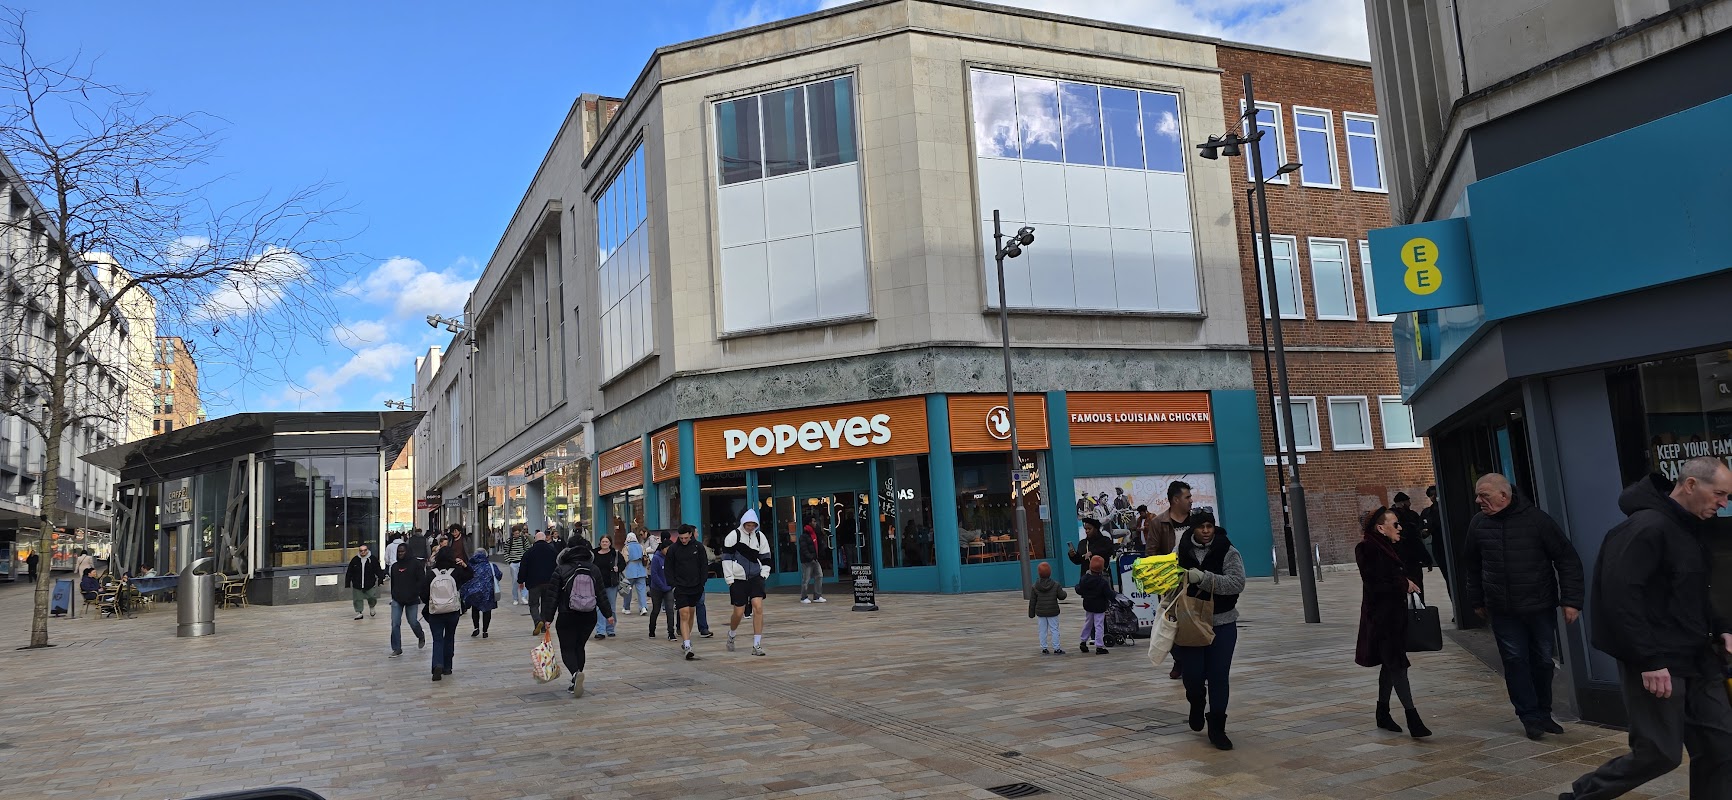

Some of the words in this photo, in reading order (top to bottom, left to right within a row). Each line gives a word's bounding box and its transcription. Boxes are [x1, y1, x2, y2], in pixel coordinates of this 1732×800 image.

[1071, 413, 1113, 423] FAMOUS
[1115, 412, 1167, 422] LOUISIANA
[1168, 412, 1209, 421] CHICKEN
[1656, 444, 1680, 460] KEEP
[1683, 441, 1711, 457] YOUR
[1660, 458, 1688, 481] SAF
[164, 498, 190, 514] NERO
